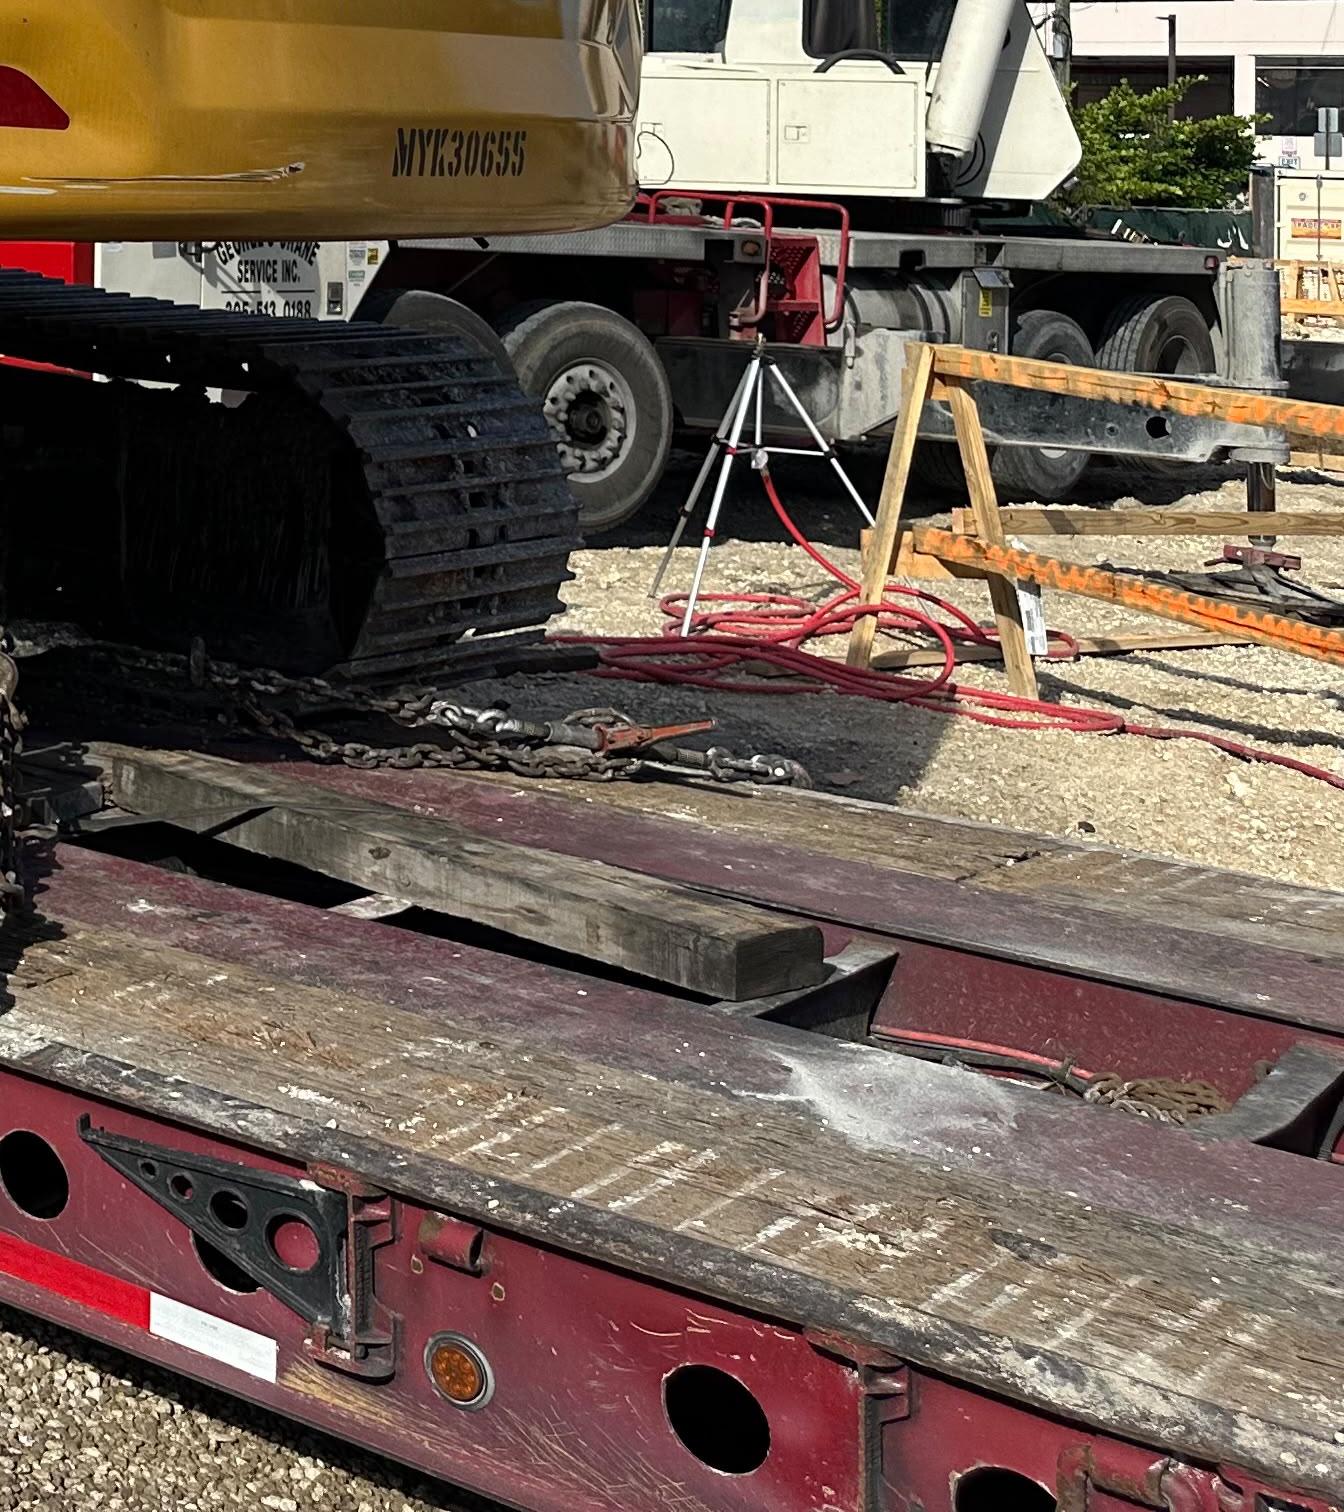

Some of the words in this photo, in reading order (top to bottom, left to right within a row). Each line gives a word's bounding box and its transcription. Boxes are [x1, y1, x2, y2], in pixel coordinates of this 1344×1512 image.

[391, 127, 527, 177] MYK30655
[237, 259, 278, 283] SERVICE
[281, 259, 301, 283] INC.
